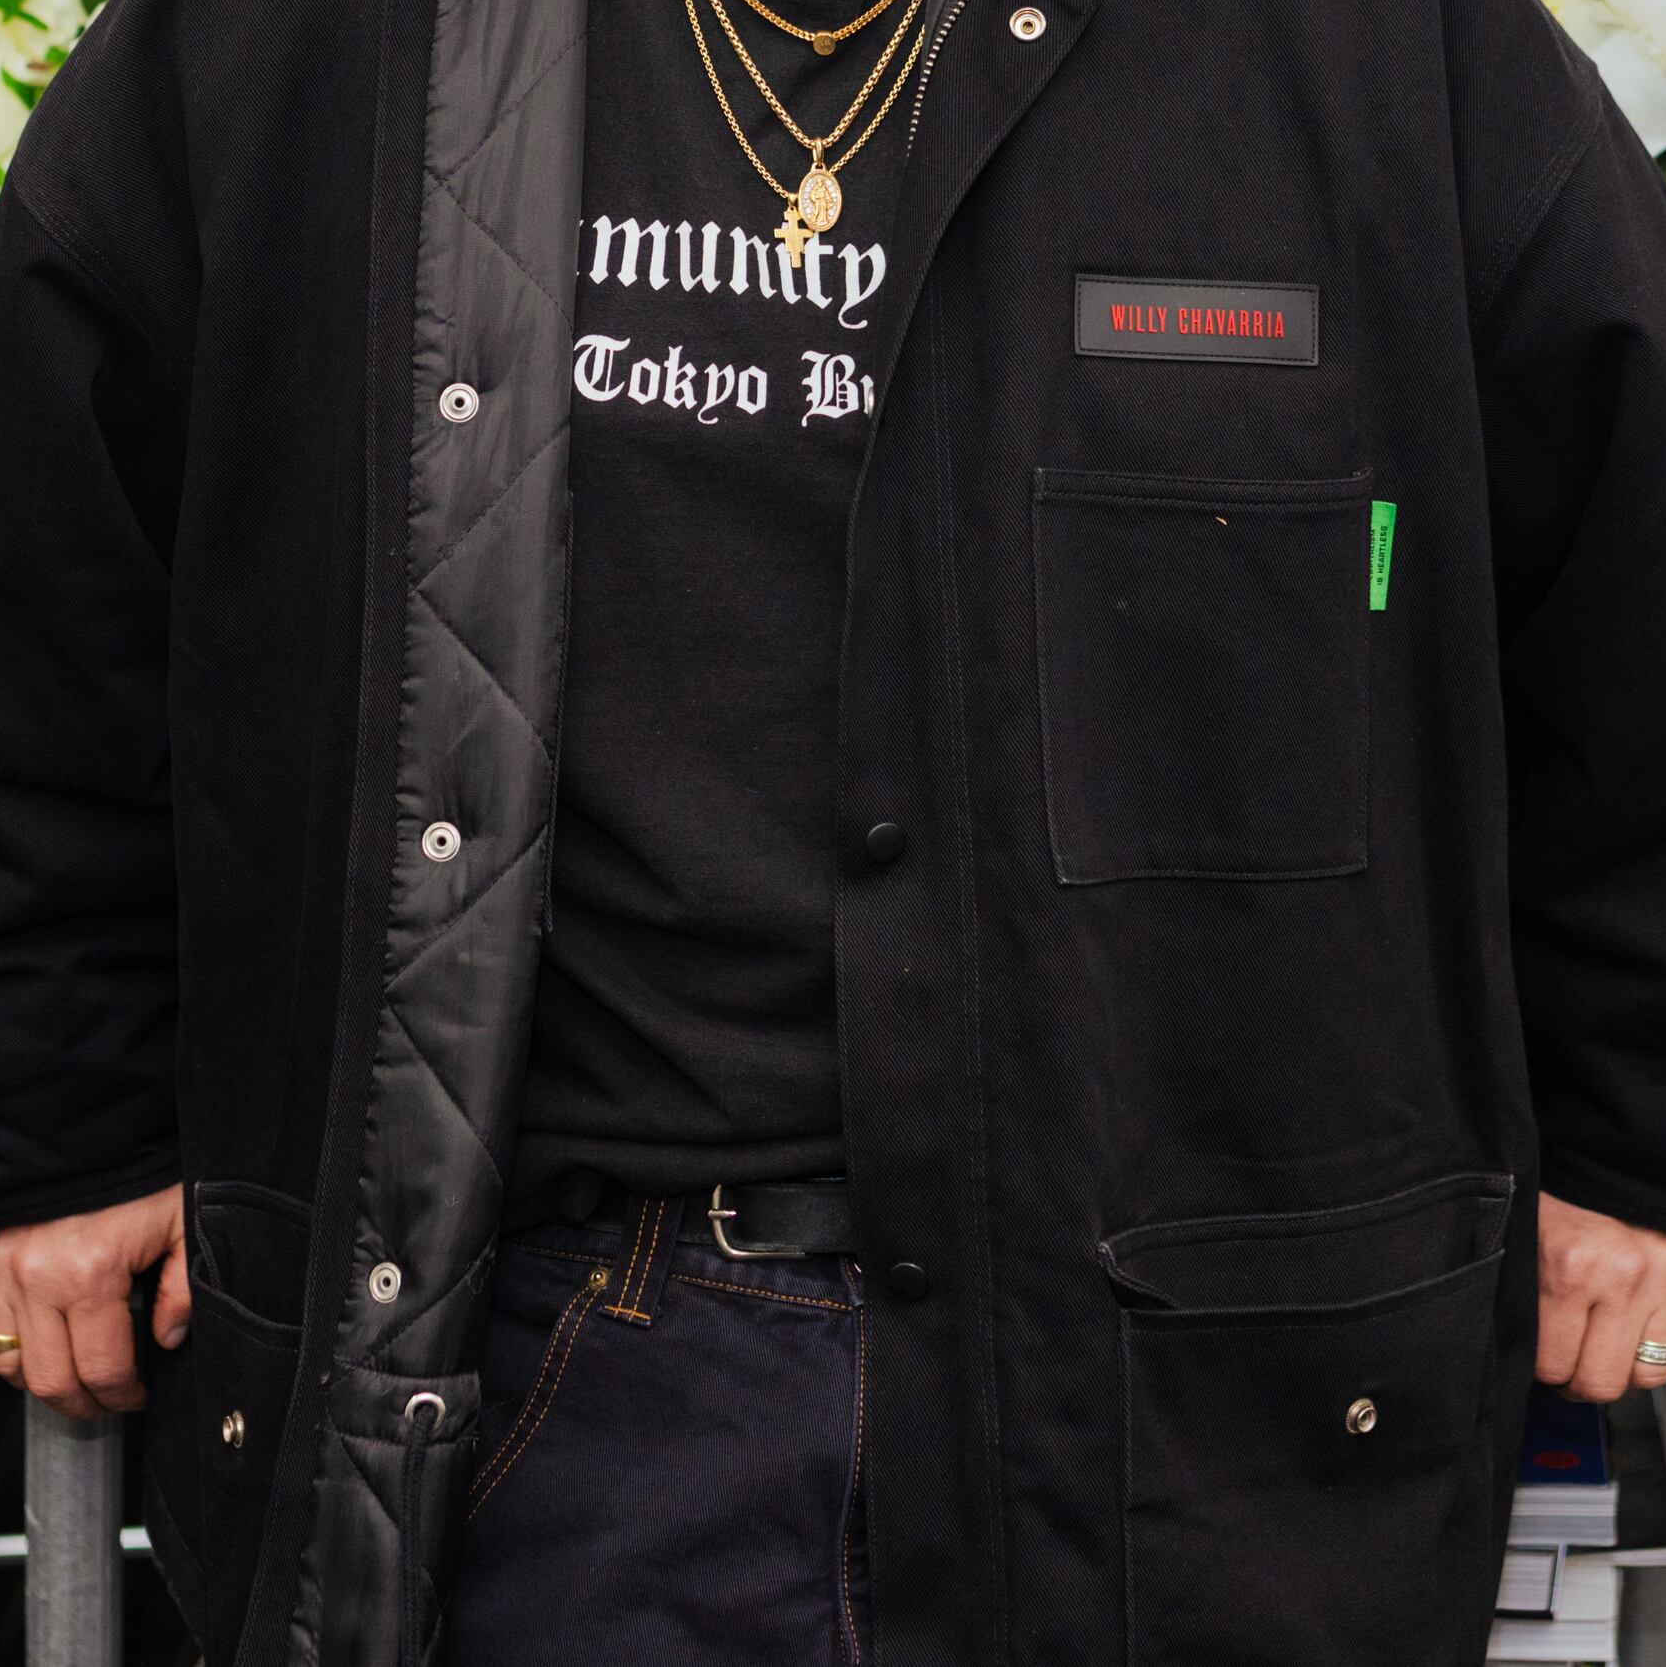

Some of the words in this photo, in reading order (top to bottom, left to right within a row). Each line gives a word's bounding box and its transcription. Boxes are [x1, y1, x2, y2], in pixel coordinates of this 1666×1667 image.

[576, 214, 887, 330] munity
[1111, 304, 1168, 334] WILLY
[1178, 307, 1285, 339] CHAVARRIA
[573, 334, 768, 425] Tokyo
[1377, 525, 1388, 574] HEARTLESS
